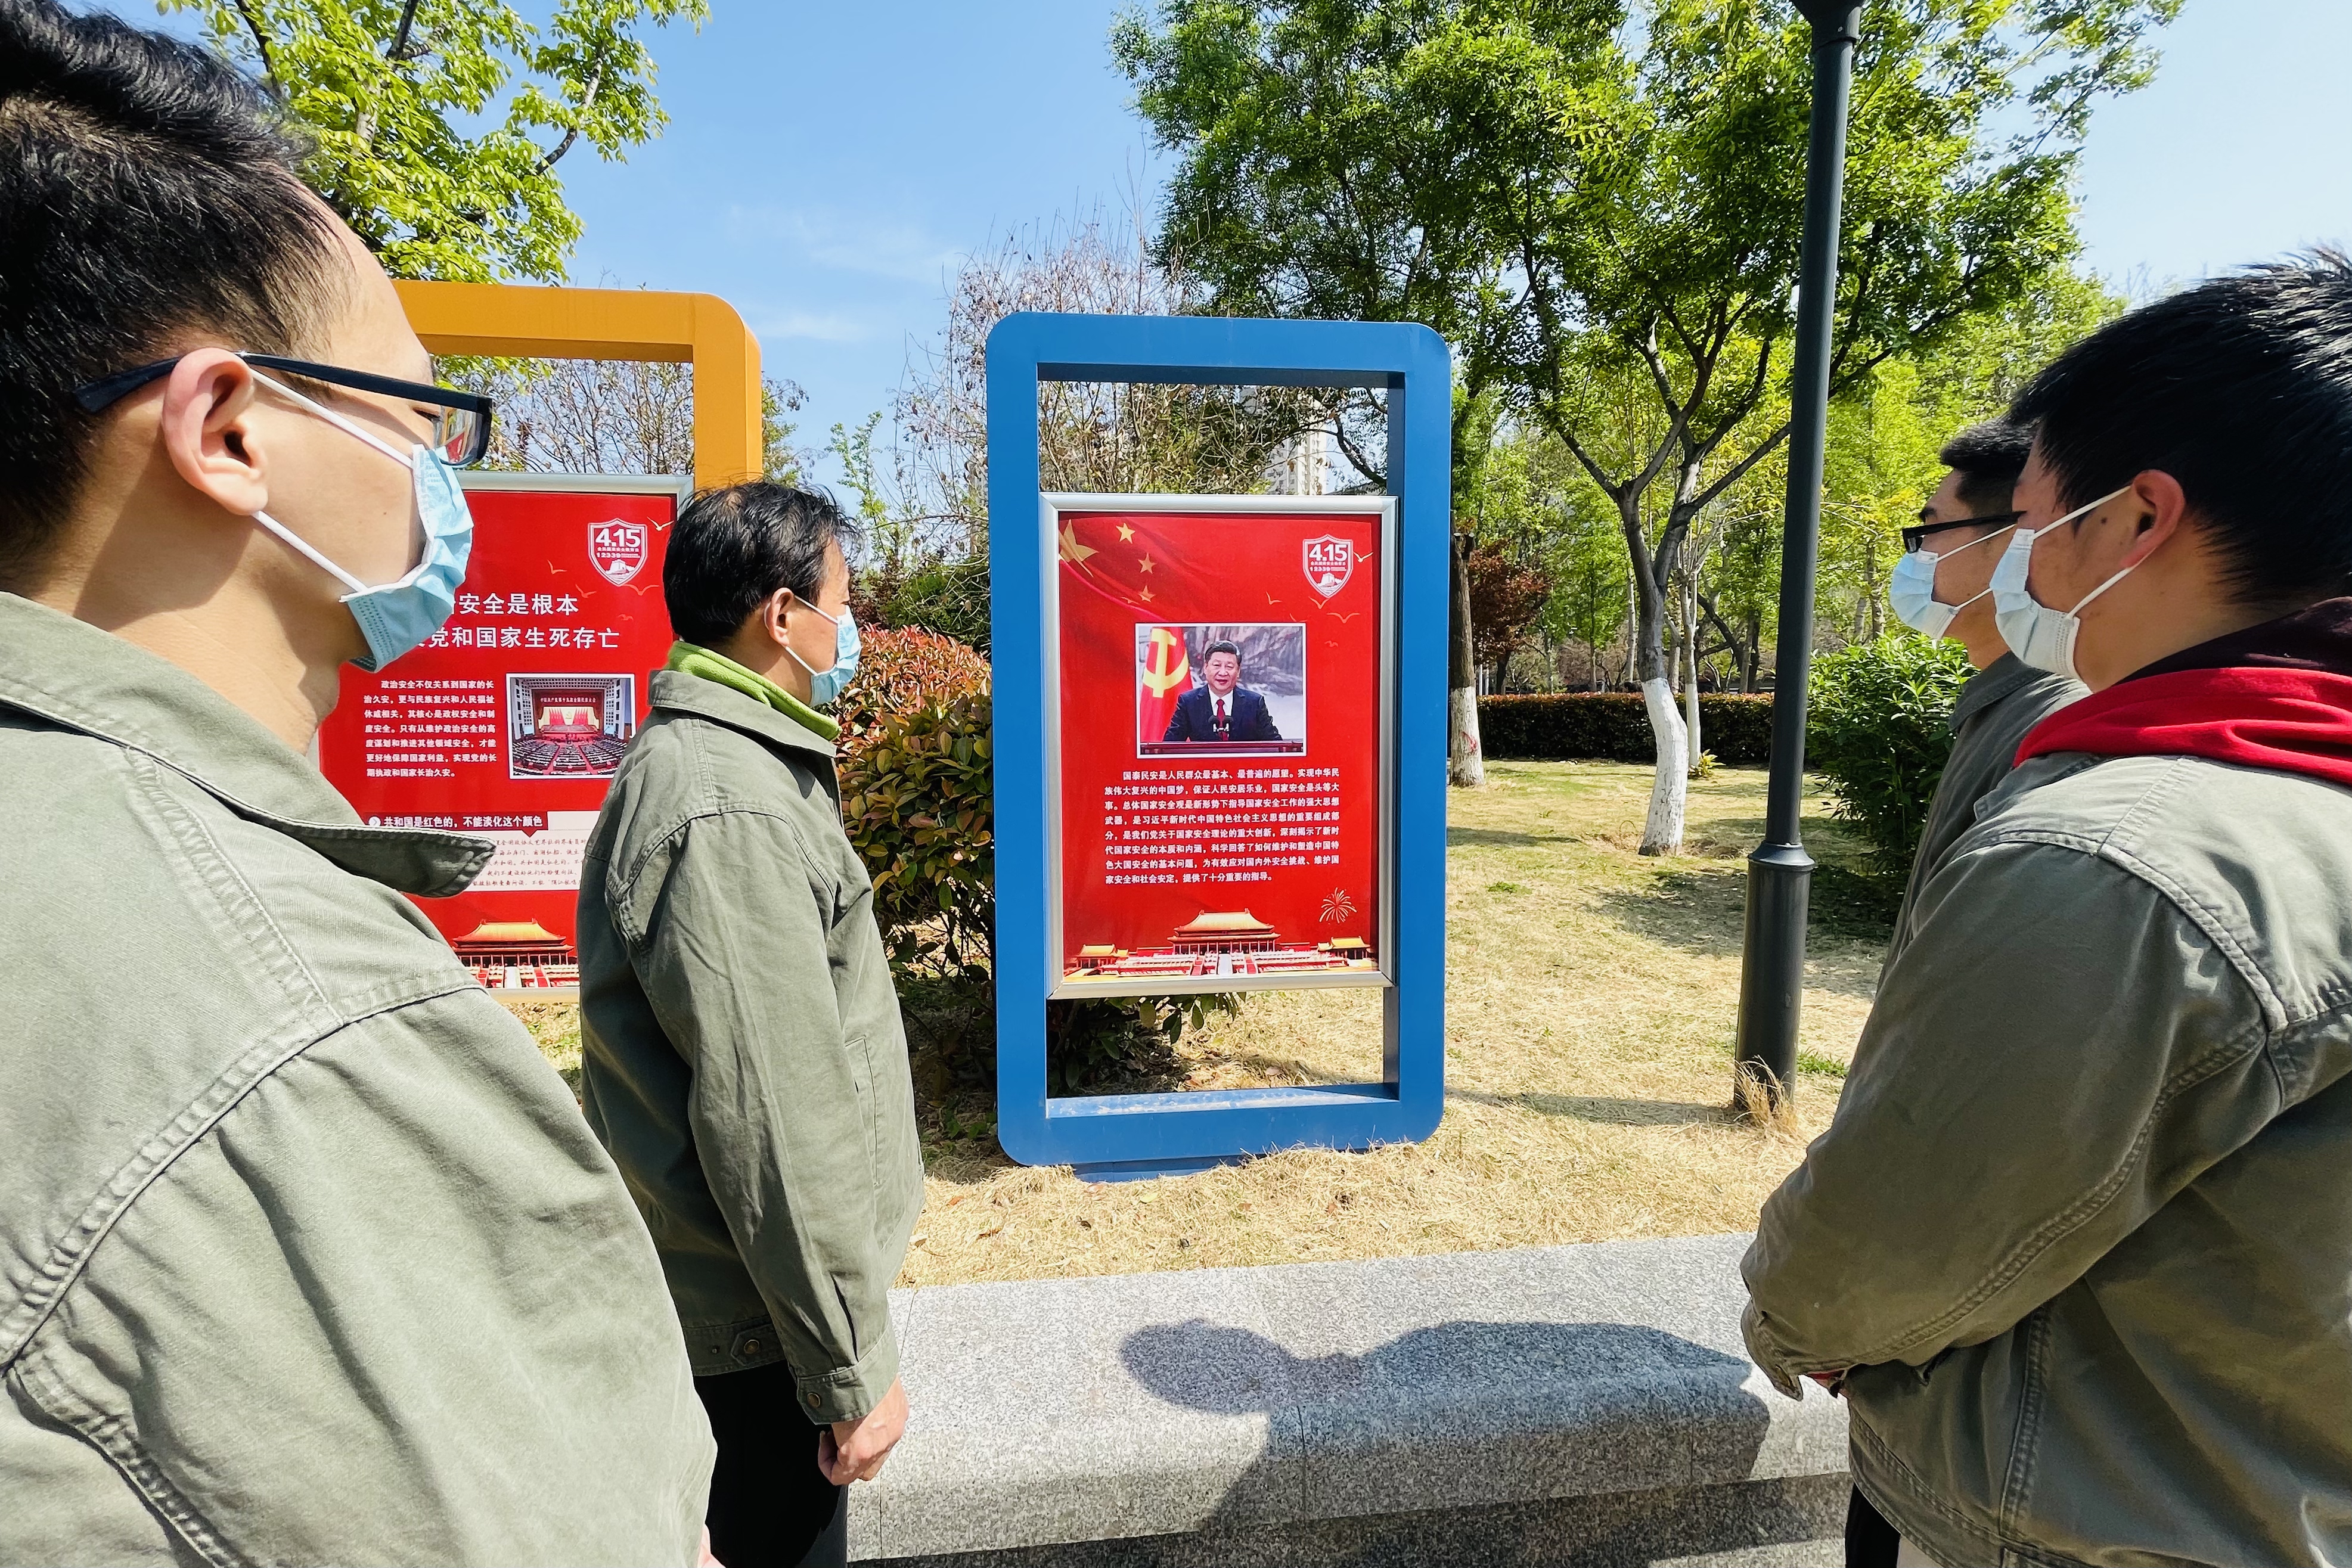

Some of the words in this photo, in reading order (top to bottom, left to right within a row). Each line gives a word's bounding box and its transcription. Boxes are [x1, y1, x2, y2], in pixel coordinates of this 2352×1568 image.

[595, 528, 640, 547] 4.15
[1309, 544, 1348, 561] 4.15
[452, 592, 579, 616] 安全是根本
[418, 626, 620, 649] 党和国家生死存亡
[381, 680, 494, 689] 政治安全不仅关系到国家的长
[367, 768, 455, 777] 期执政和国家长治久安。
[384, 816, 542, 827] 共和国是红色的，不能淡化这个颜色
